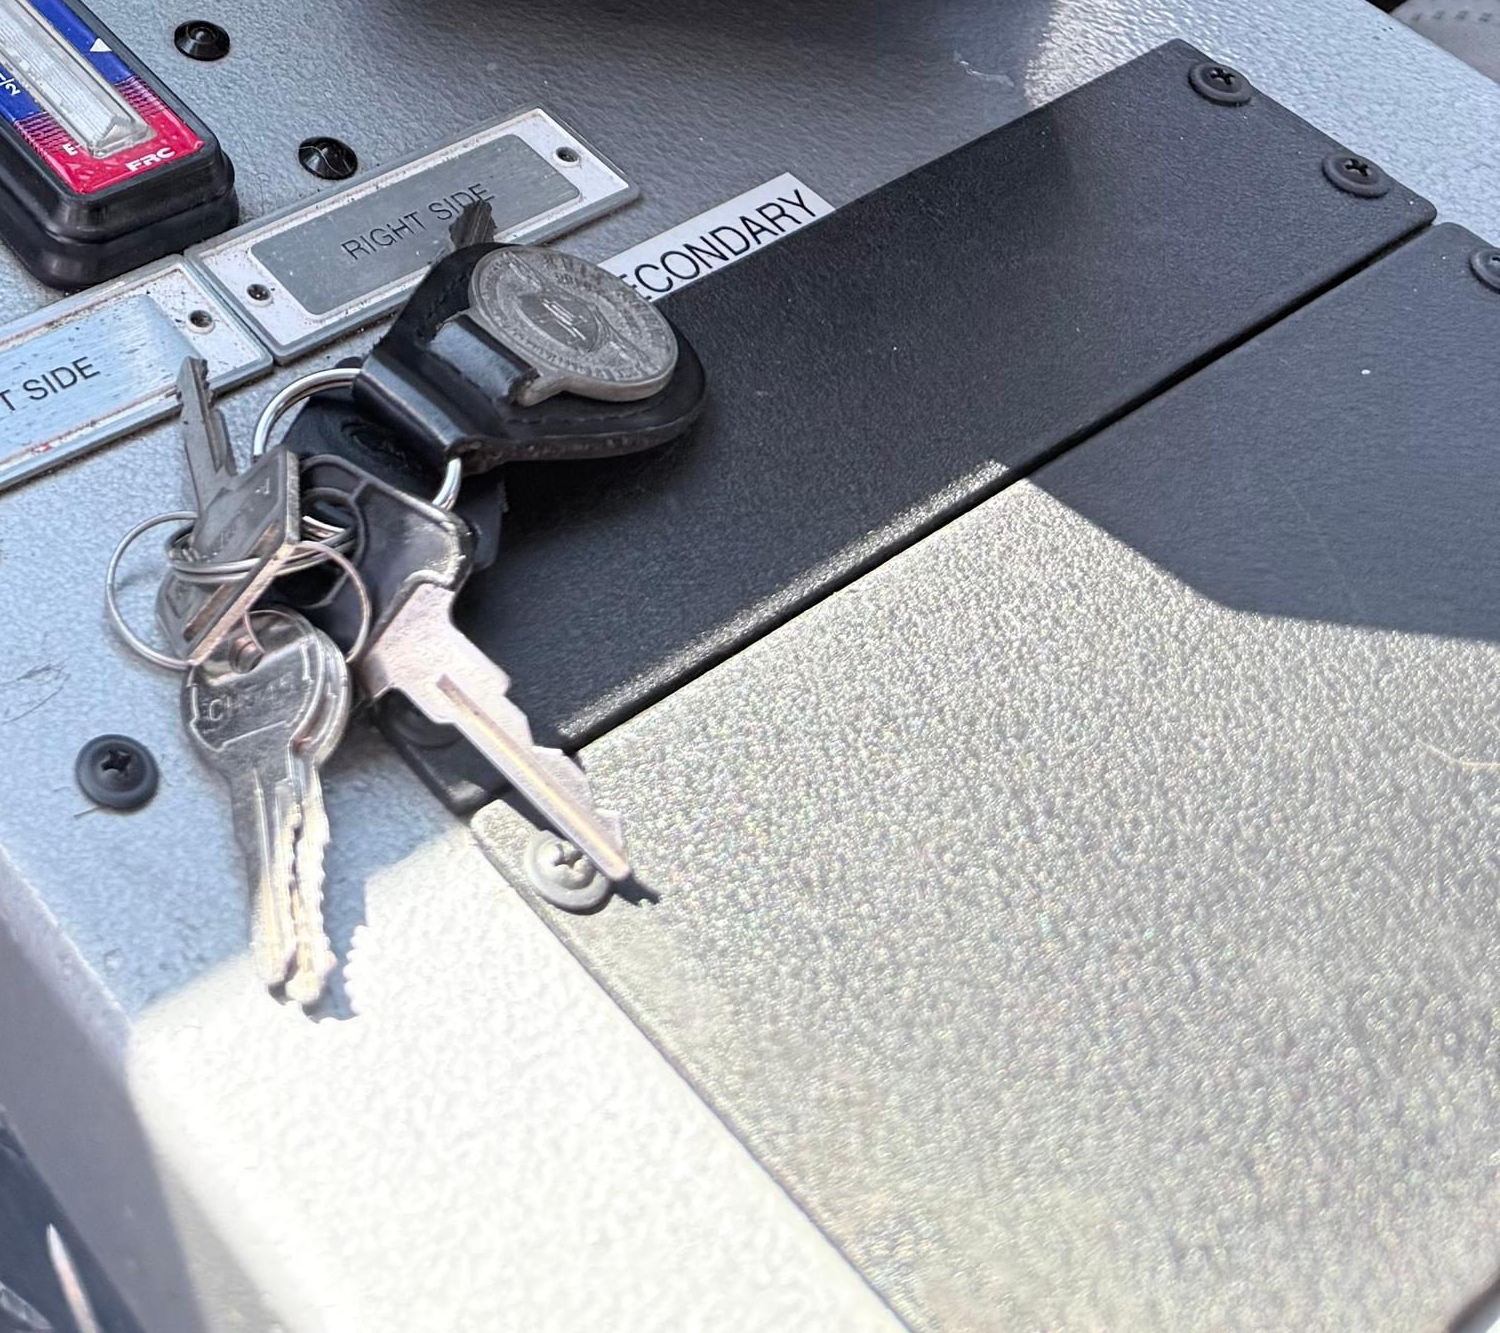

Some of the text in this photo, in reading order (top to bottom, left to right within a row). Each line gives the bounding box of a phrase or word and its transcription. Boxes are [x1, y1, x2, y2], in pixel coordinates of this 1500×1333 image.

[62, 142, 78, 156] E
[125, 147, 175, 171] FRC
[341, 183, 495, 261] RIGHT SIDE
[22, 356, 101, 402] SIDE
